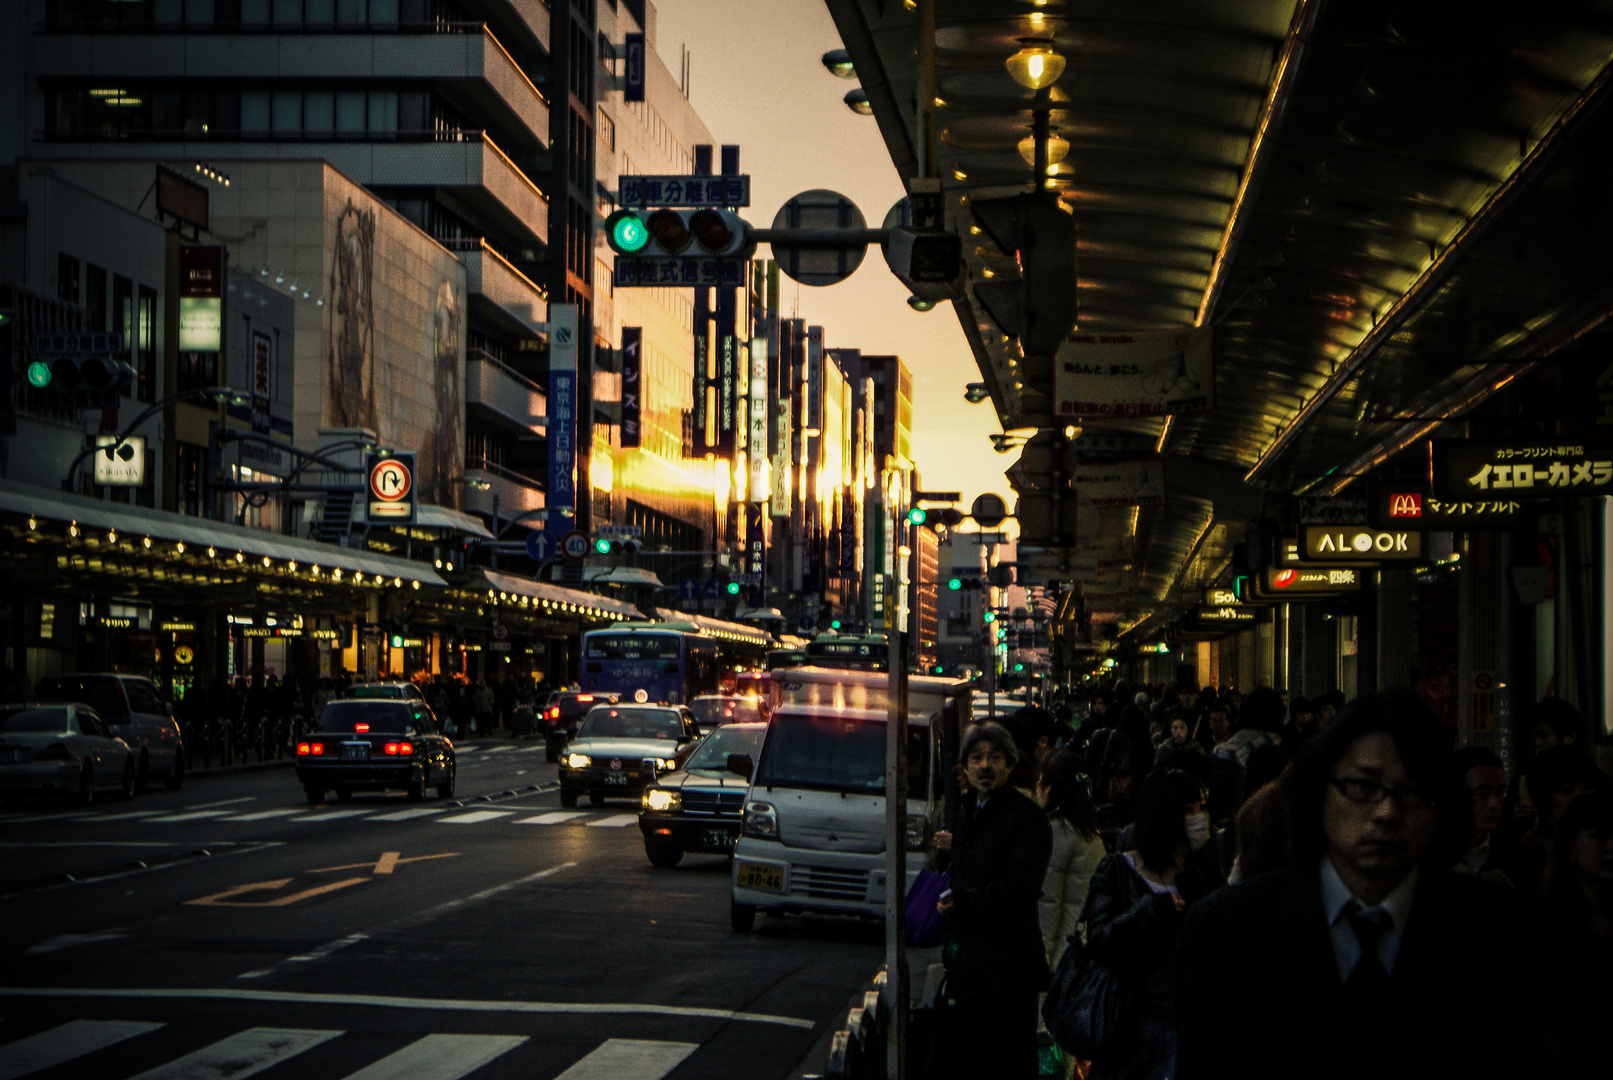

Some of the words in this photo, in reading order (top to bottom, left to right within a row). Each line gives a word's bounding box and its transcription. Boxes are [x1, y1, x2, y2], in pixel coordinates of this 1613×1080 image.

[625, 179, 745, 203] 歩車分離信号
[619, 260, 739, 282] 時差式信号機
[556, 377, 571, 493] 東京海上日動火災
[1496, 445, 1585, 459] カラープリント専門店
[1469, 460, 1613, 490] イエローカメラ
[568, 538, 585, 551] 40
[1319, 533, 1408, 552] ALOOK
[859, 645, 871, 656] 3
[748, 873, 780, 888] 80-46
